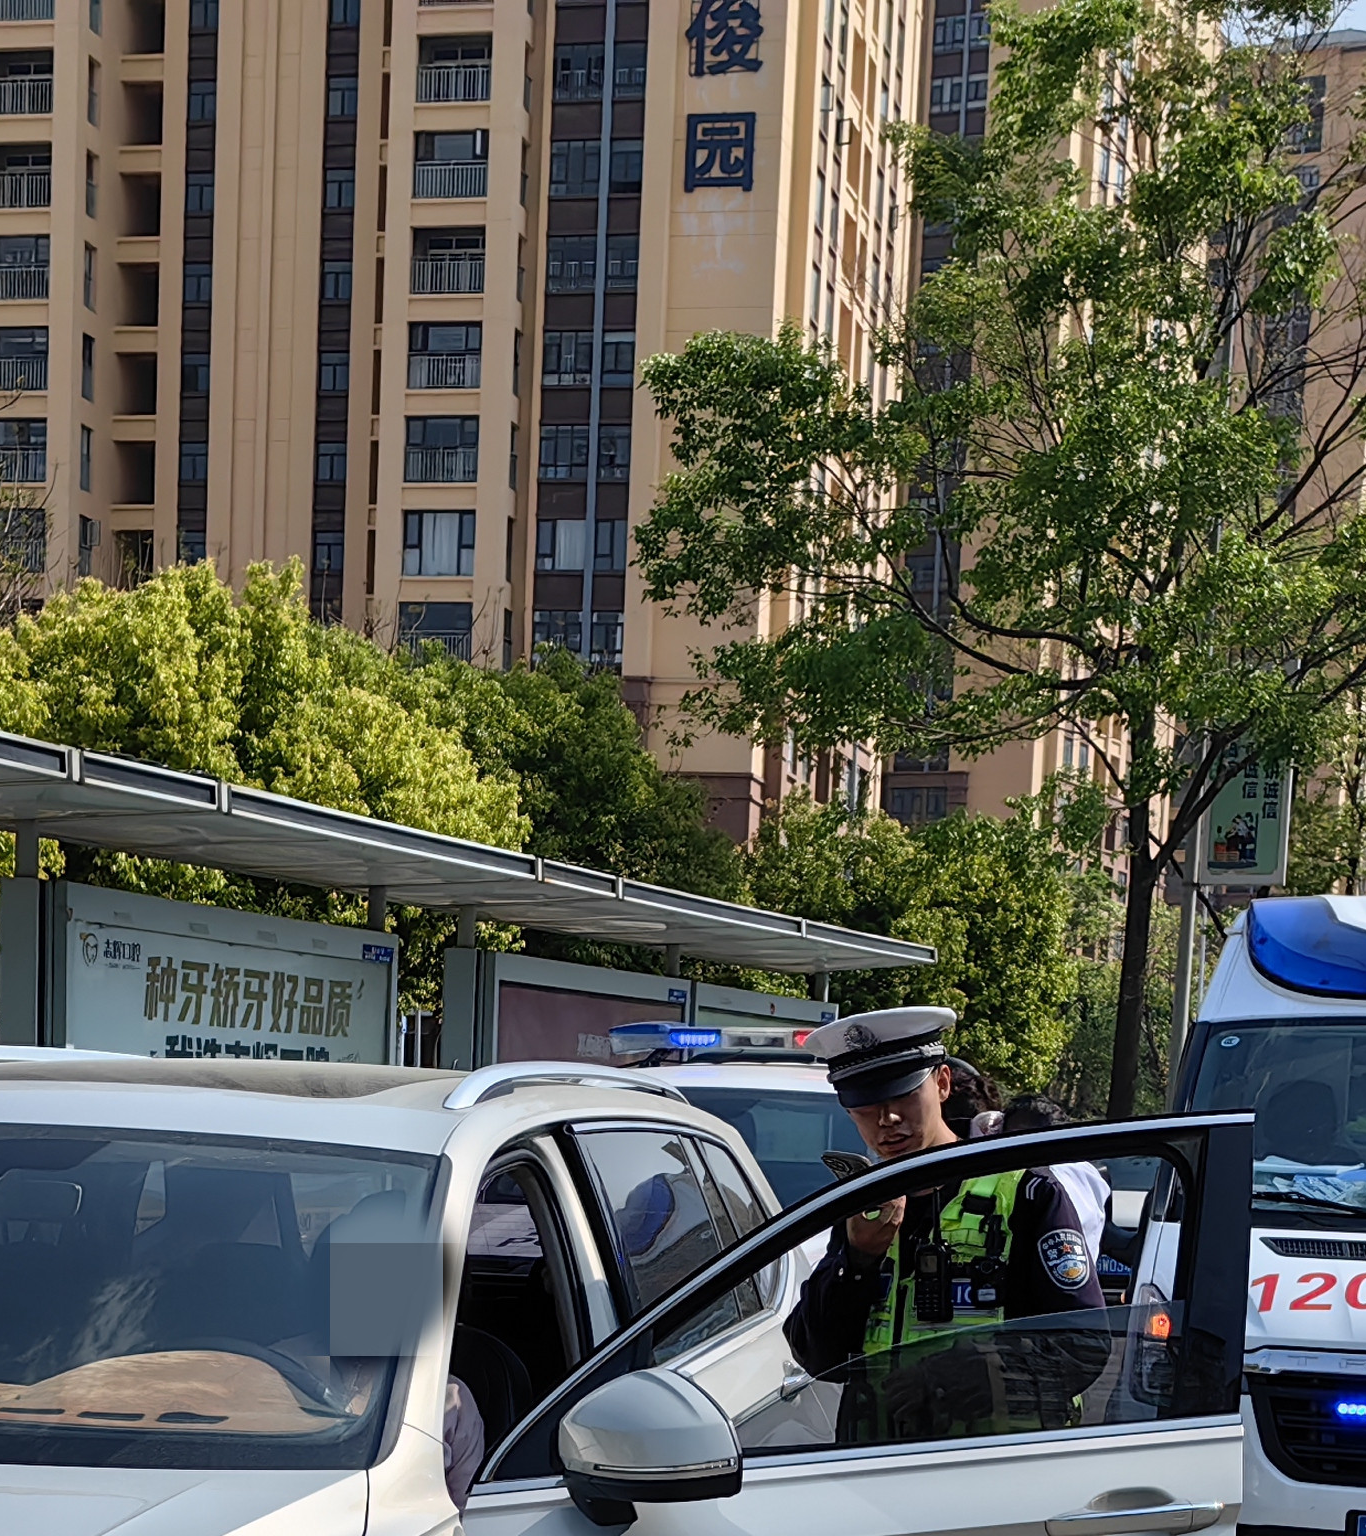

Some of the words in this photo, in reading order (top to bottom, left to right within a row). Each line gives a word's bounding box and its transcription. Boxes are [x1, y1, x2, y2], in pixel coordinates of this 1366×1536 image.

[685, 0, 763, 193] 俊园
[143, 956, 354, 1037] 种牙矫牙好品质
